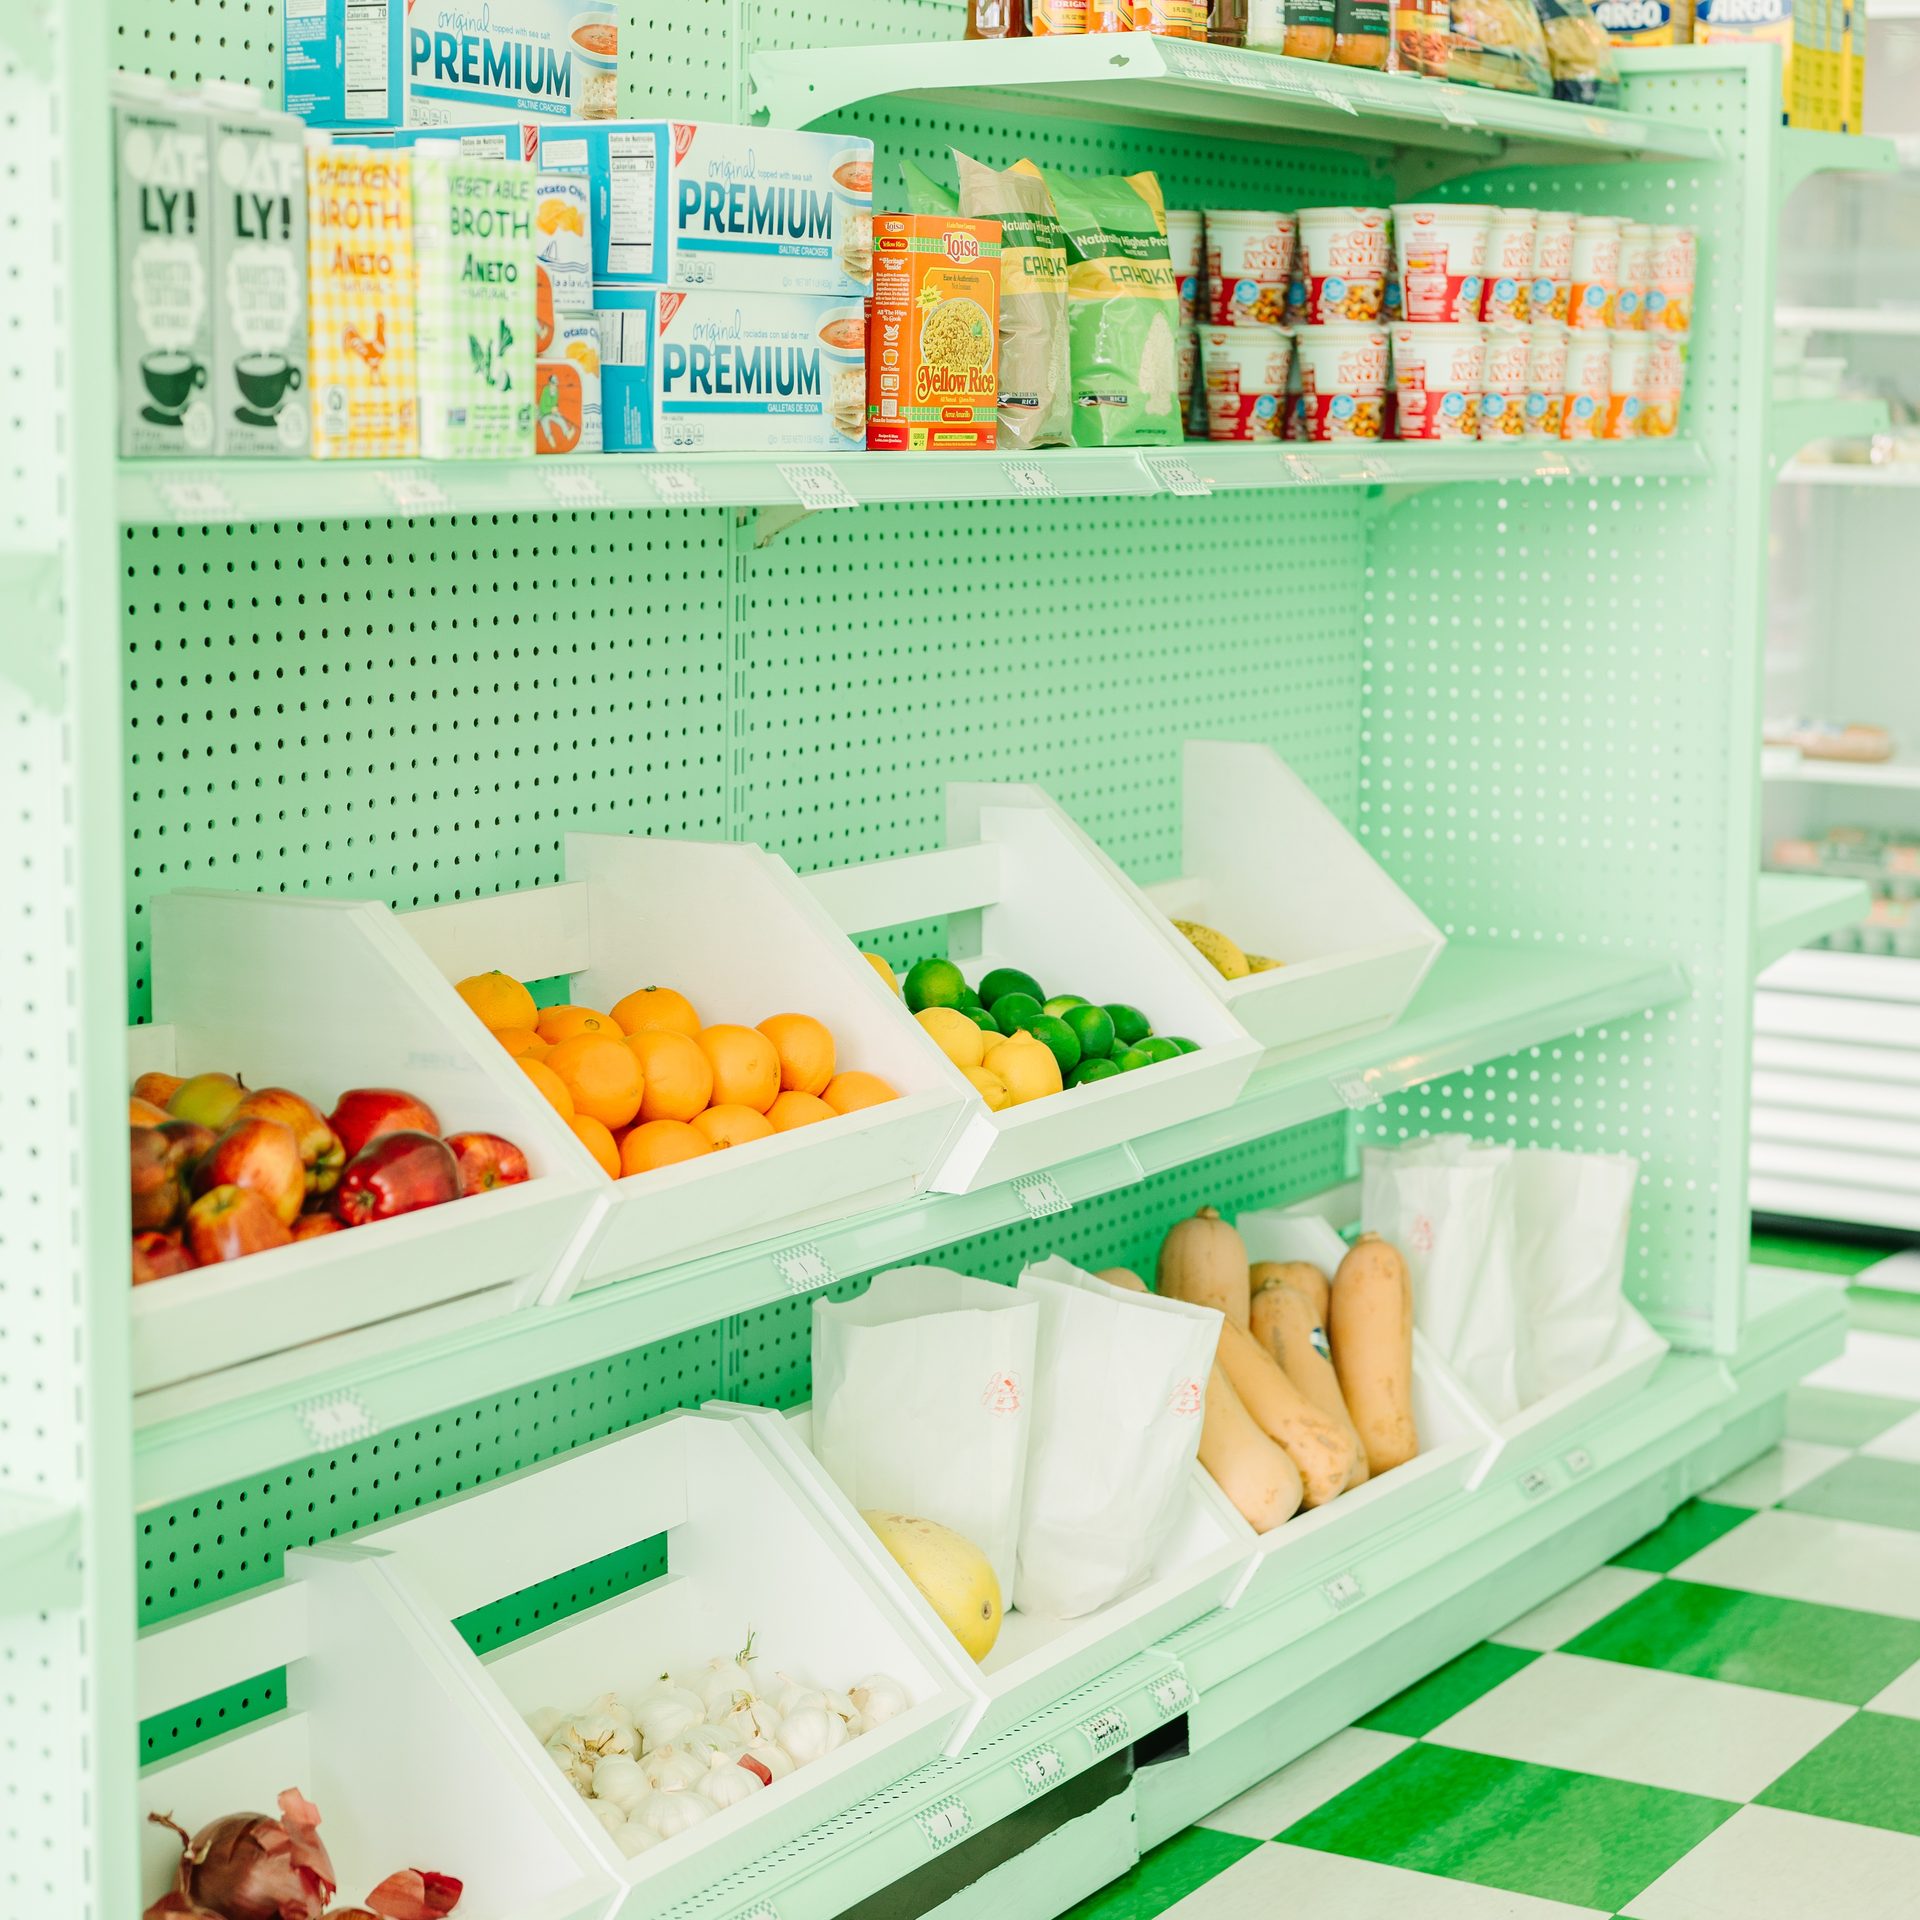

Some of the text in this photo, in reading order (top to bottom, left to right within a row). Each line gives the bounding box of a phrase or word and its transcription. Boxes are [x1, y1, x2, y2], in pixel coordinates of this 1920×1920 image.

[411, 27, 571, 98] PREMIUM
[517, 99, 567, 114] SALTINE CRACKERS
[537, 186, 566, 196] otato
[140, 187, 196, 235] LY!
[236, 193, 291, 240] LY!
[450, 207, 530, 239] BROTH
[678, 180, 833, 240] PREMIUM
[779, 245, 829, 257] SALTINE CRACKERS
[943, 233, 979, 261] Loisa
[1077, 235, 1122, 246] Naturally
[1123, 236, 1149, 248] Higher
[564, 328, 588, 338] otato
[663, 343, 821, 396] PREMIUM
[917, 365, 994, 401] Yellow Rice
[768, 403, 819, 413] GALLETAS DE SODA
[1036, 1761, 1046, 1777] 5
